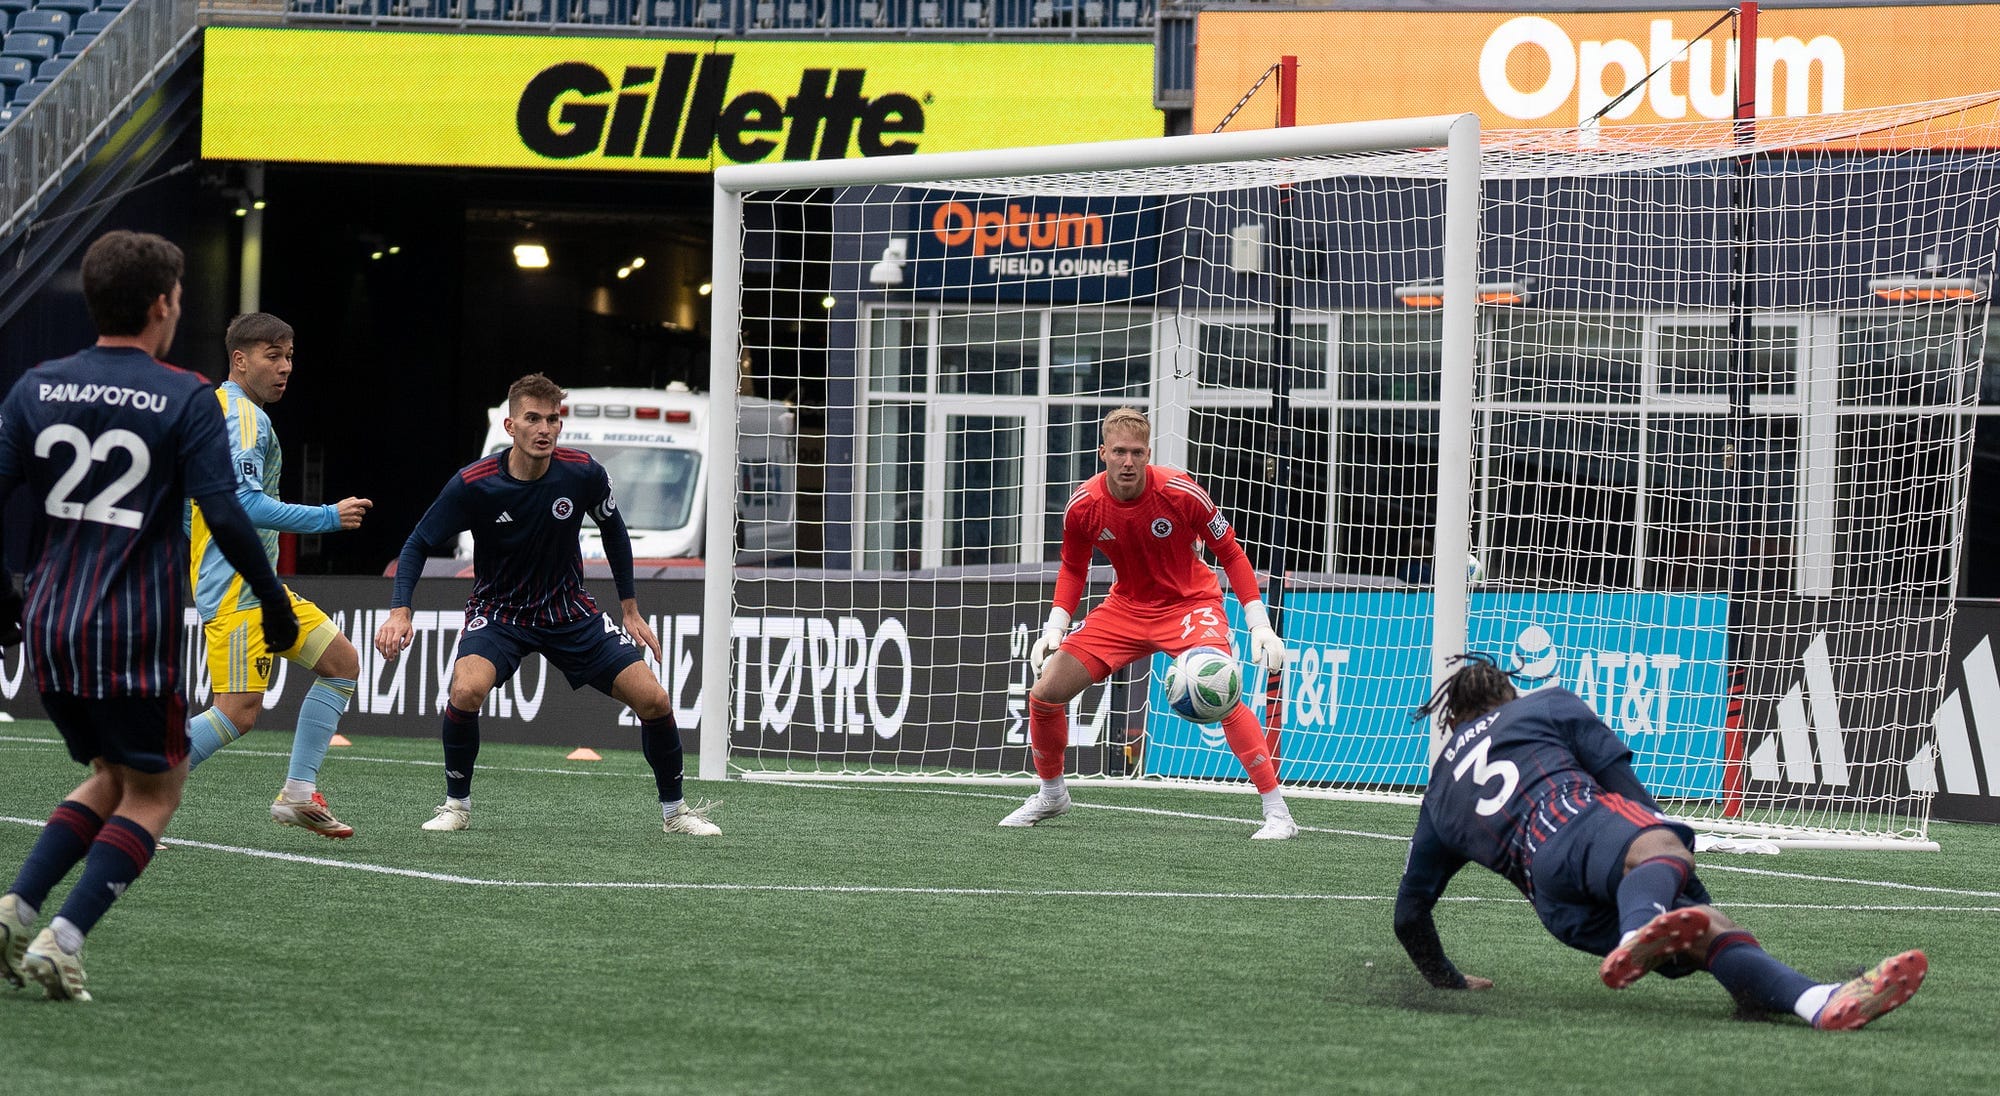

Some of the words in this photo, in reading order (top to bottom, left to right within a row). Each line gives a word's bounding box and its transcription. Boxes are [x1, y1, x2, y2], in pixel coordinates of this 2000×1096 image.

[516, 52, 926, 163] Gillette
[1478, 16, 1845, 148] Optum
[932, 200, 1104, 257] Optum
[989, 257, 1045, 277] FIELD
[1049, 257, 1130, 277] LOUNGE
[38, 383, 168, 413] PANAYOTOU
[602, 432, 676, 444] MEDICAL
[34, 423, 150, 530] 22
[1180, 606, 1220, 641] 13
[1006, 622, 1029, 744] MLS
[1575, 653, 1681, 736] AT&T
[1444, 711, 1501, 763] BARRY
[1453, 735, 1520, 817] 3
